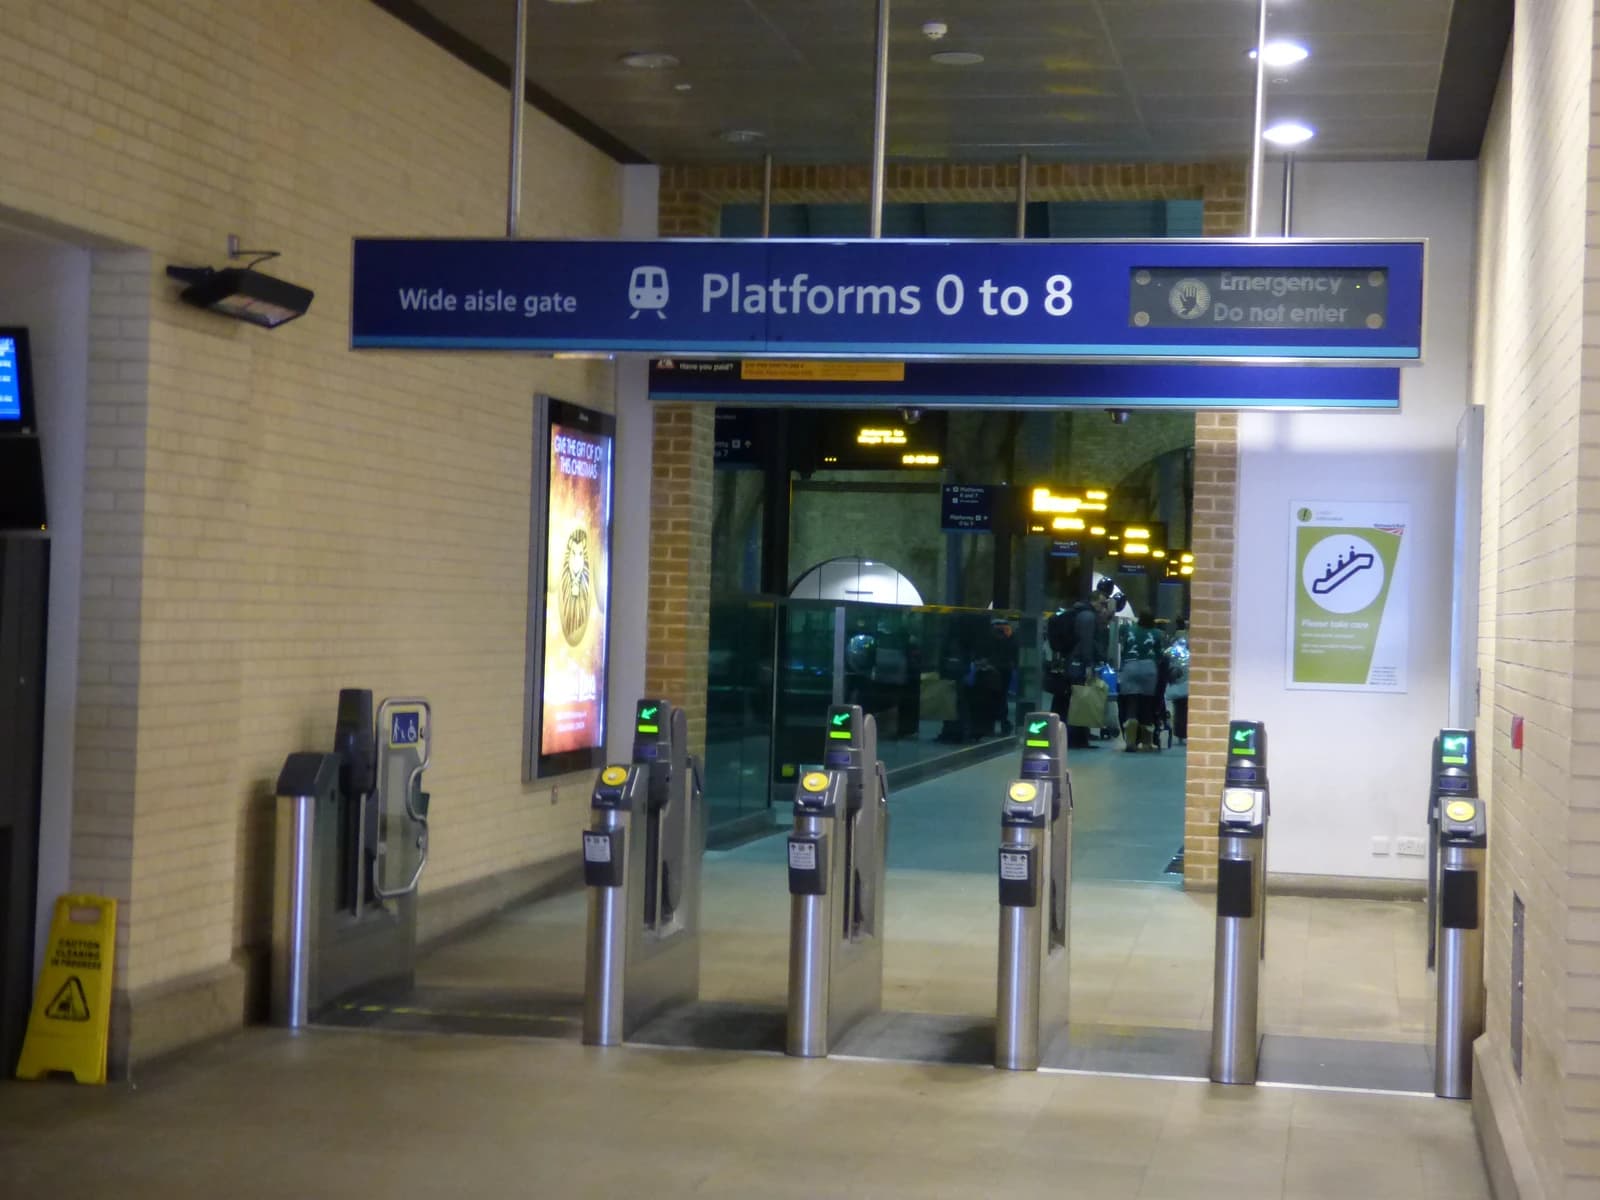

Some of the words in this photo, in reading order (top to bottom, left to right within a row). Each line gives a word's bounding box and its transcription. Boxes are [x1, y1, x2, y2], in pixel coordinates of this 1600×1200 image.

[702, 271, 921, 315] Platforms
[935, 274, 965, 316] 0
[978, 279, 1029, 316] to
[1043, 274, 1073, 316] 8
[1220, 271, 1344, 296] Emergency
[399, 288, 457, 312] Wide
[464, 289, 517, 312] aisle
[524, 292, 577, 317] gate
[1213, 303, 1243, 322] Do
[1250, 304, 1285, 323] not
[1290, 305, 1349, 324] enter
